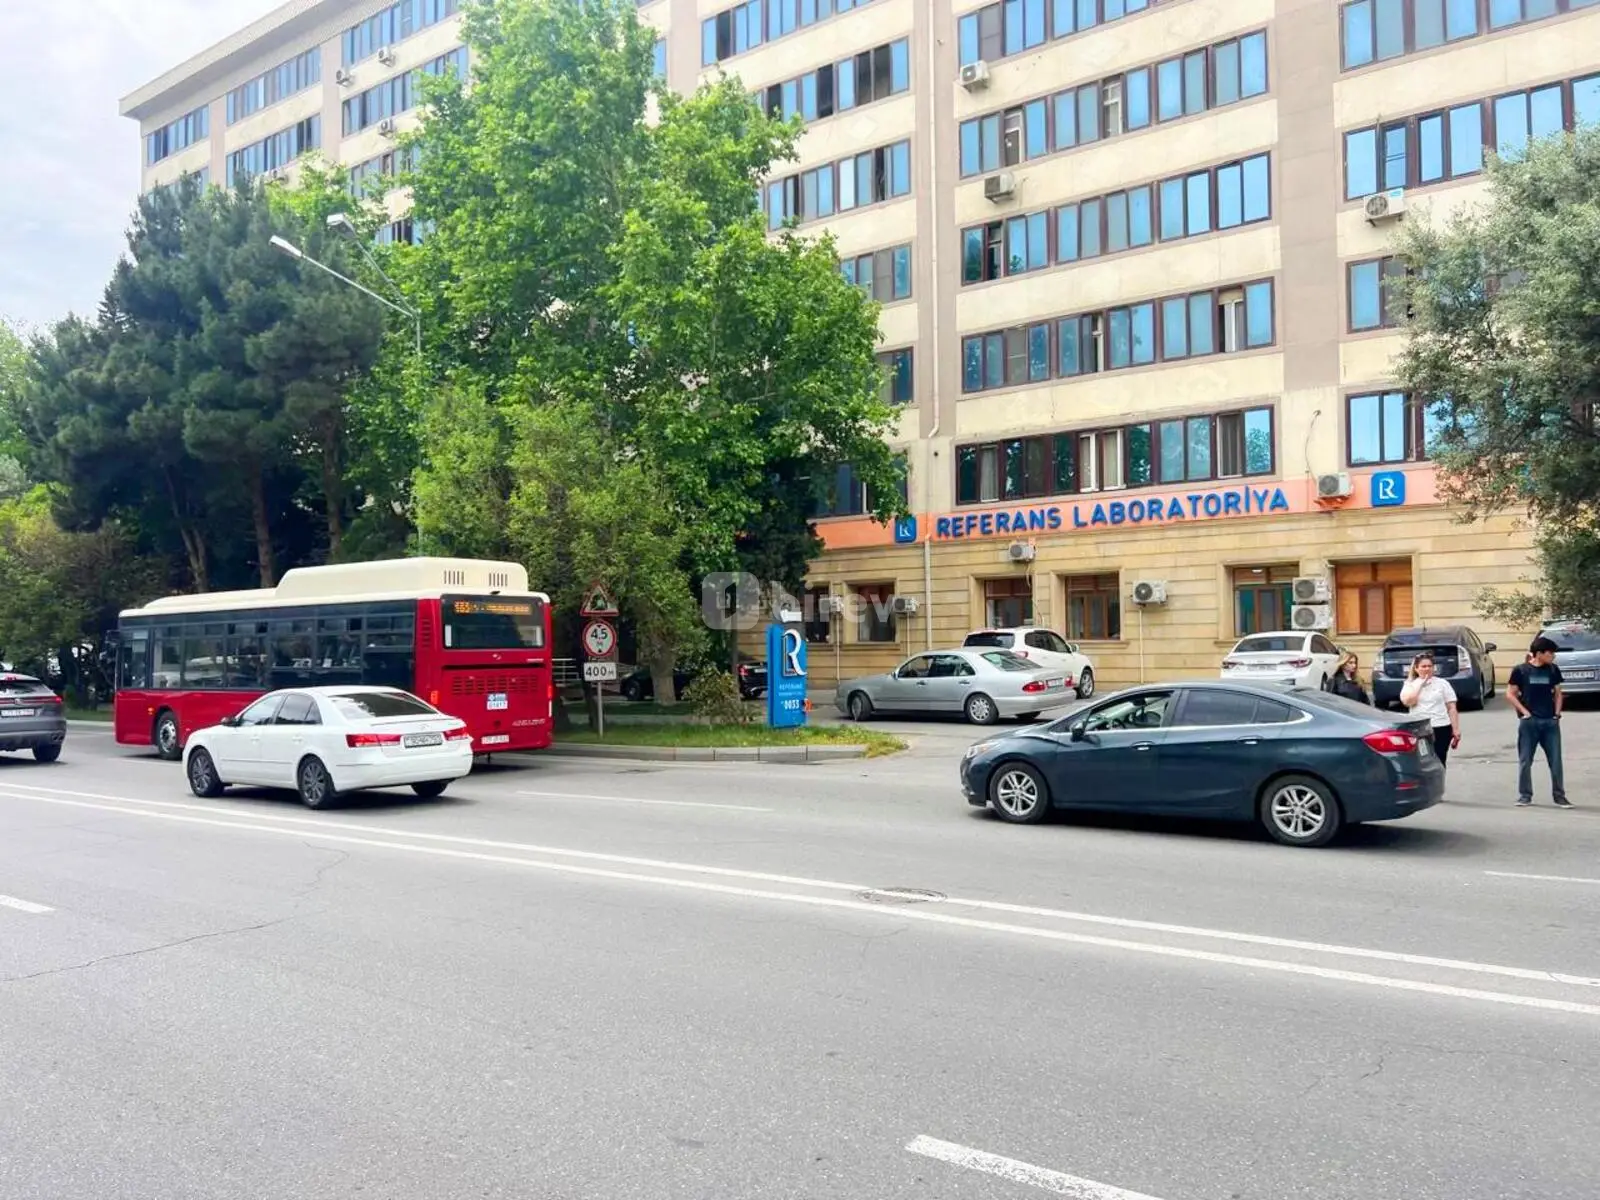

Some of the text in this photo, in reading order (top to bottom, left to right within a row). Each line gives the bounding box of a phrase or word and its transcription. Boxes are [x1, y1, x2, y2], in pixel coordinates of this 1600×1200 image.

[936, 485, 1289, 537] REFERANS LABORATORİYA
[586, 666, 607, 676] 400
